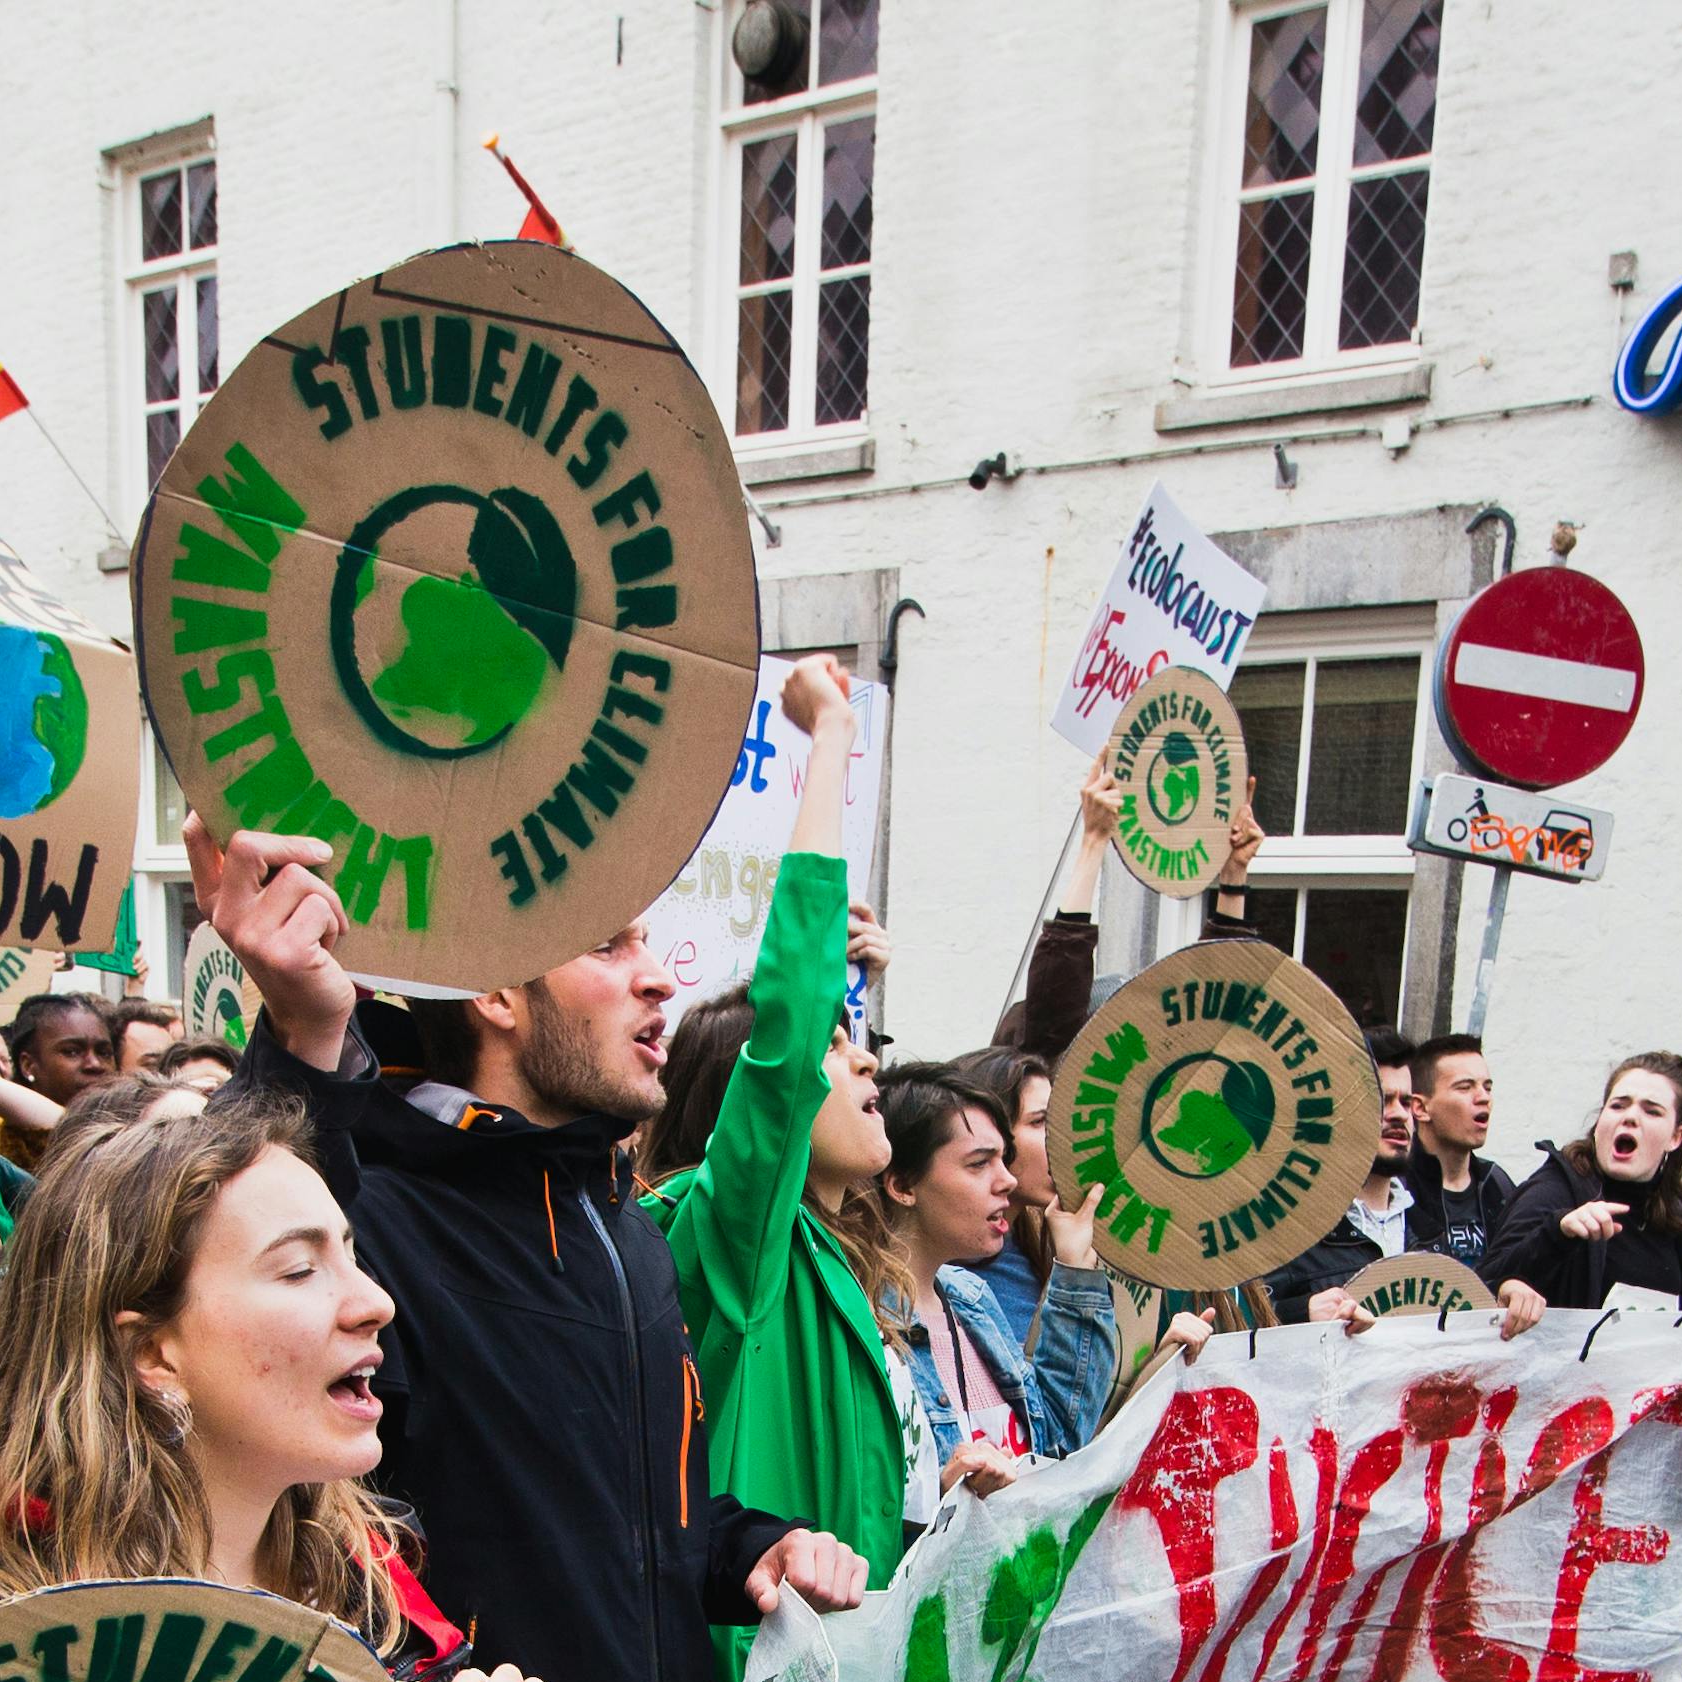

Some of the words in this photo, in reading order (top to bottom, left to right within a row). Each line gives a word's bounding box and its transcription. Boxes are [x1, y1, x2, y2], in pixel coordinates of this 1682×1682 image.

[291, 314, 629, 490] STUDENTS
[591, 470, 678, 633] FOR
[490, 651, 673, 908] CLIMATE
[1114, 691, 1178, 782] STUDENTS
[1181, 695, 1212, 734] FOR
[1205, 725, 1231, 823] CLIMATE
[1118, 794, 1210, 881] MAASTRICHT
[1161, 979, 1319, 1070] STUDENTS
[1290, 1068, 1335, 1145] FOR
[1197, 1151, 1322, 1260] CLIMATE
